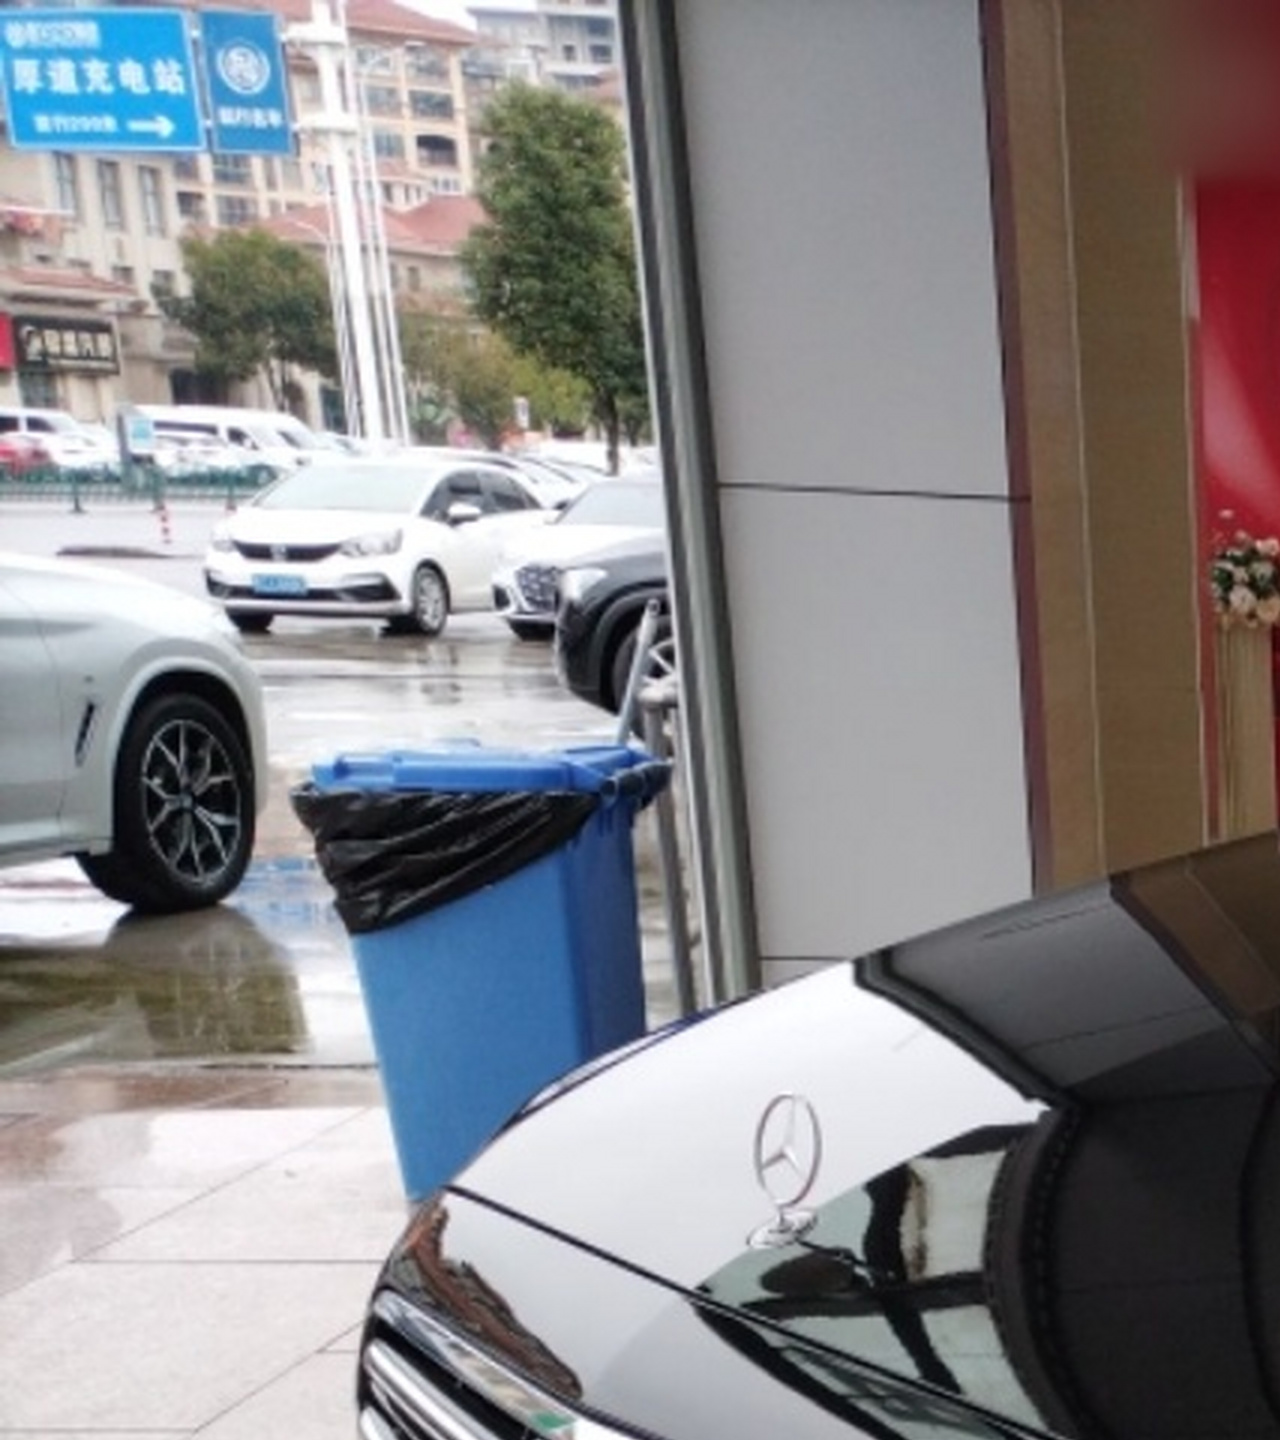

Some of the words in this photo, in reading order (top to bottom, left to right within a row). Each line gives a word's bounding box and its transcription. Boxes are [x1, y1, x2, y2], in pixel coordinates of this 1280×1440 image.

[13, 57, 186, 95] 厚道充电站
